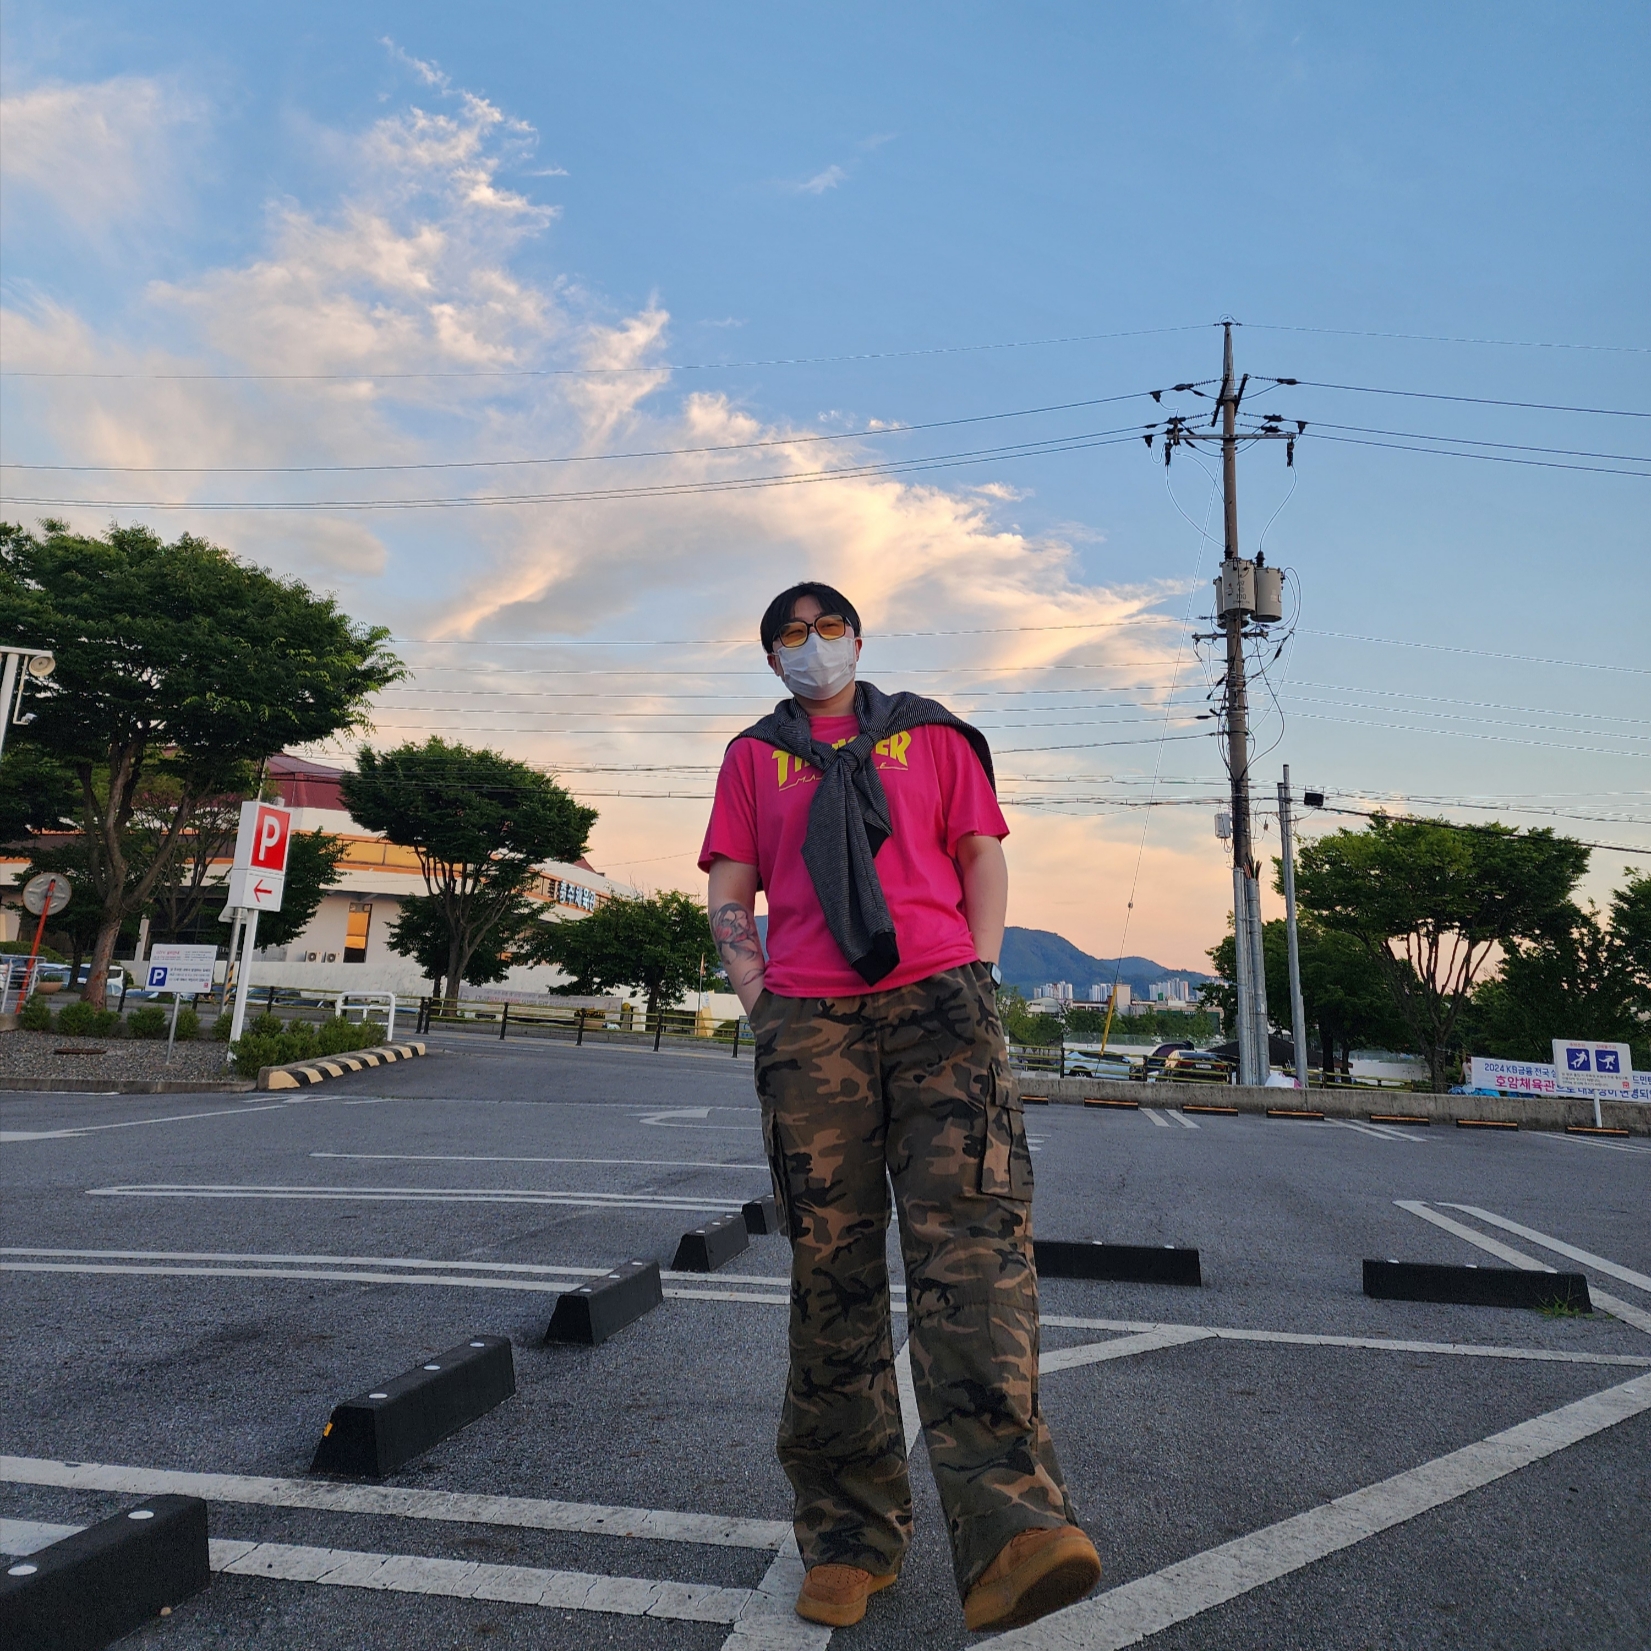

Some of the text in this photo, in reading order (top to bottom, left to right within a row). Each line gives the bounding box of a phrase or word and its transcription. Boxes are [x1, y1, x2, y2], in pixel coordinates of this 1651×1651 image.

[259, 815, 280, 861] P
[152, 969, 165, 985] P
[1484, 1063, 1505, 1073] 2024
[1506, 1065, 1533, 1077] KB금융
[1534, 1067, 1550, 1079] 전국
